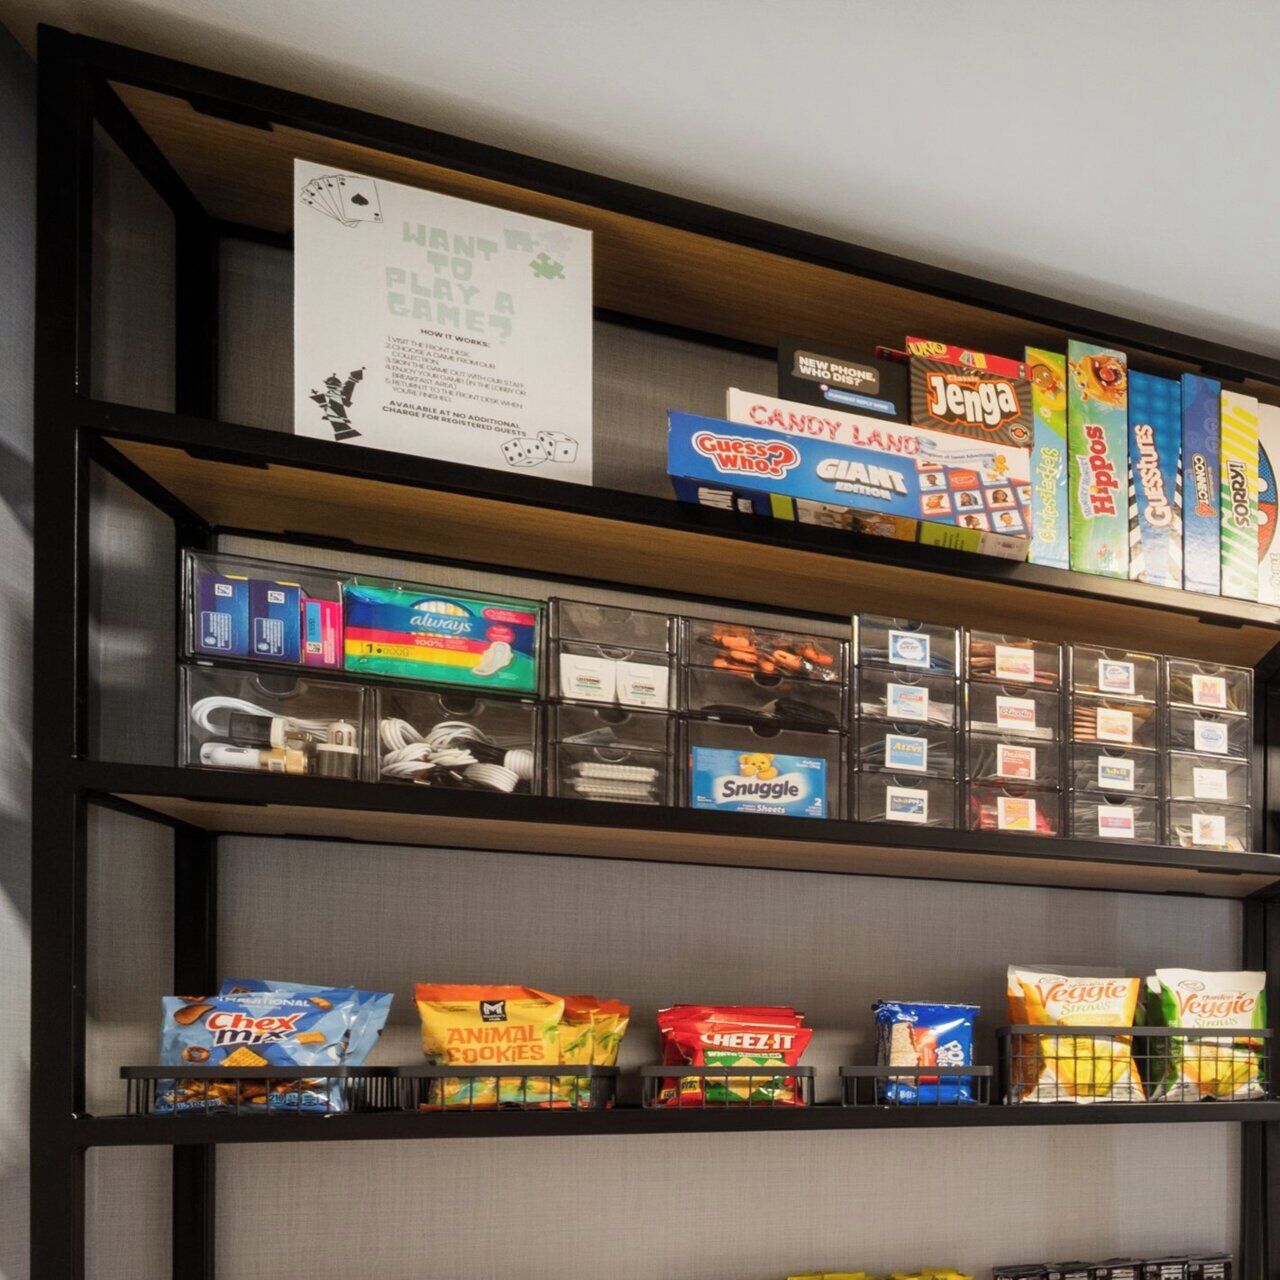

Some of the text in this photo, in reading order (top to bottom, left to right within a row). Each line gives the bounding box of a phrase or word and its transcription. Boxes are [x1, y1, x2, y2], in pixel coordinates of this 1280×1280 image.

[402, 221, 498, 262] WANT
[426, 252, 473, 282] TO
[385, 266, 516, 316] PLAY A
[386, 291, 513, 344] GAME?
[420, 329, 443, 339] HOW
[909, 341, 948, 358] UNO
[799, 356, 876, 383] NEW PHONE,
[799, 366, 863, 387] WHO DIS?
[389, 400, 521, 429] AVAILABLE AT NO ADDITIONAL
[931, 376, 1017, 426] Jenga
[382, 406, 527, 437] CHARGE FOR REGISTERED GUESTS
[749, 403, 921, 455] CANDY LAND
[698, 435, 766, 457] Guess
[720, 444, 798, 476] Who?
[1084, 424, 1119, 518] Hippos
[816, 457, 909, 494] GIANT
[1192, 453, 1216, 517] CONNECT 4
[835, 480, 892, 501] EDITION
[1226, 460, 1250, 528] SORRY!
[409, 612, 473, 635] always
[722, 780, 799, 800] Snuggle
[756, 803, 786, 815] Sheets
[1035, 981, 1127, 1009] Veggie
[1060, 1001, 1112, 1016] Straws
[1175, 990, 1255, 1018] Veggie
[205, 1011, 307, 1032] Chex
[447, 1024, 542, 1044] ANIMAL
[213, 1027, 296, 1046] mix
[700, 1032, 796, 1050] CHEEZ-IT
[445, 1044, 545, 1064] COOKIES
